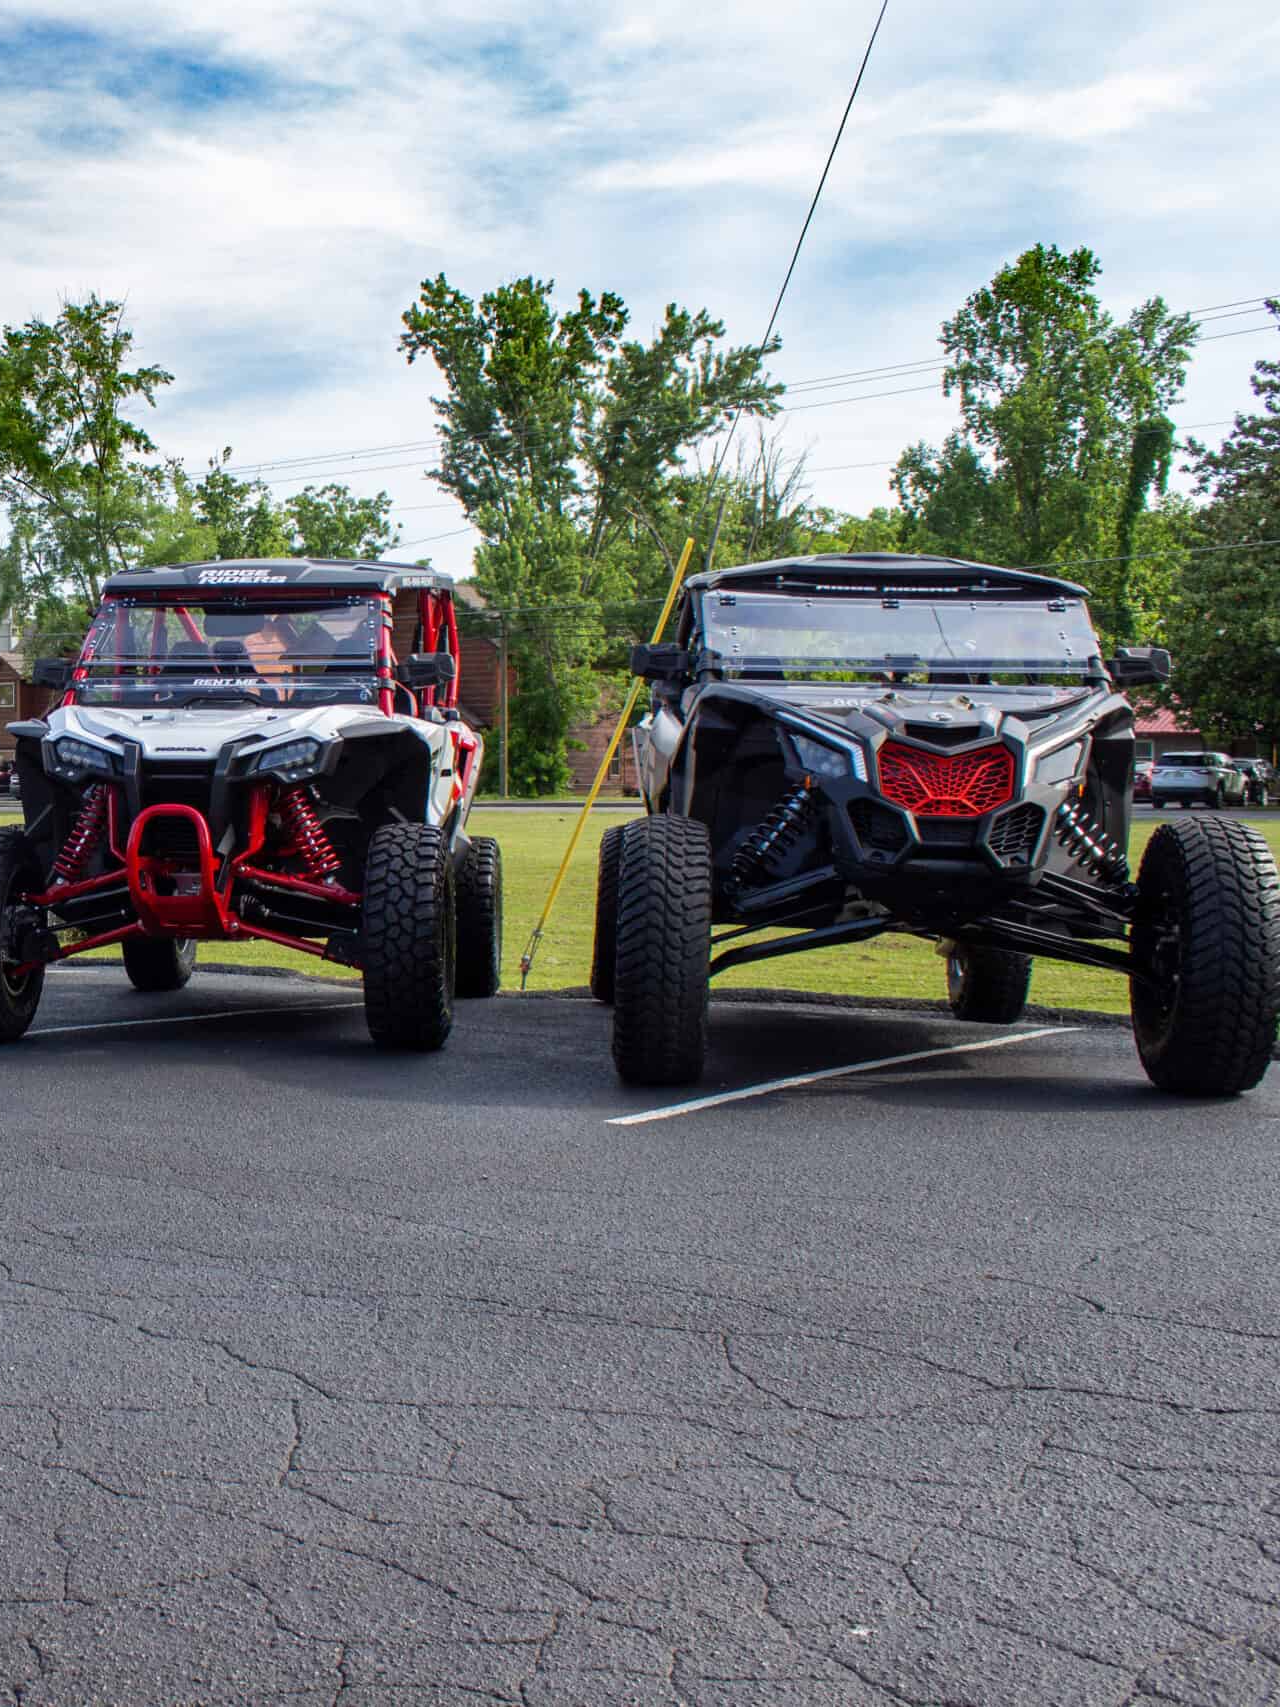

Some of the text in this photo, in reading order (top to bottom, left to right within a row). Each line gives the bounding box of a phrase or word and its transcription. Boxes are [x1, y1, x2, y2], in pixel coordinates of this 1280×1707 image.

[198, 569, 272, 578] RIDGE
[198, 576, 288, 584] RIDERS
[193, 679, 259, 687] RENT ME
